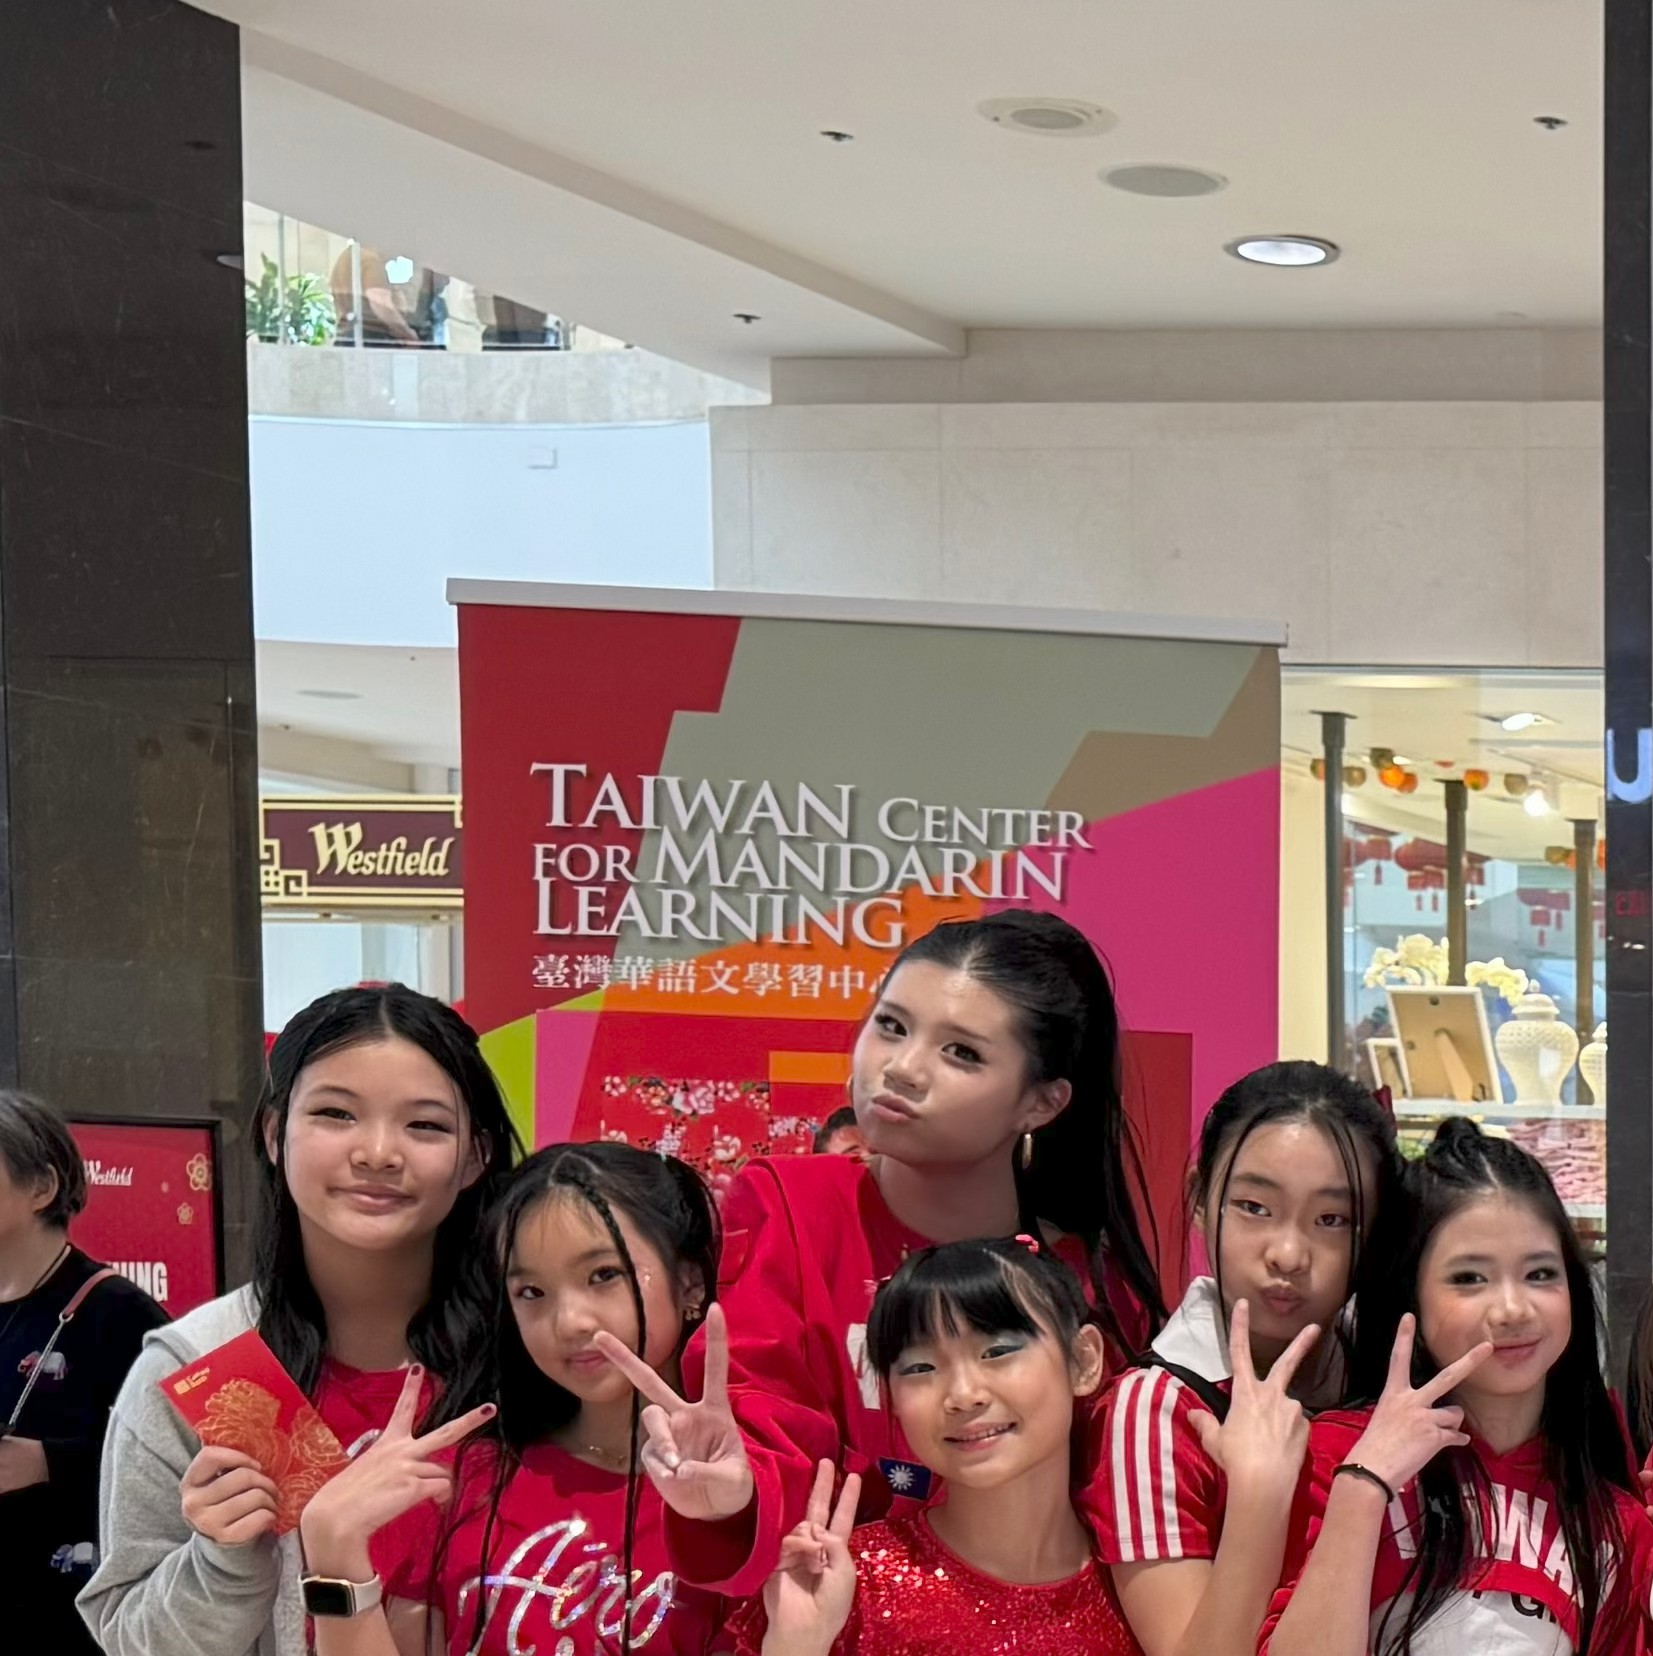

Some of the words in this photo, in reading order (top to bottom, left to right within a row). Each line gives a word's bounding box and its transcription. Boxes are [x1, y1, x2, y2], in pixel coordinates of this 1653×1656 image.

[530, 761, 856, 841] TAIWAN
[876, 797, 1094, 850] CENTER
[307, 821, 456, 877] Westfield
[532, 843, 638, 884] FOR
[652, 825, 1067, 902] MANDARIN
[533, 876, 906, 951] LEARNING
